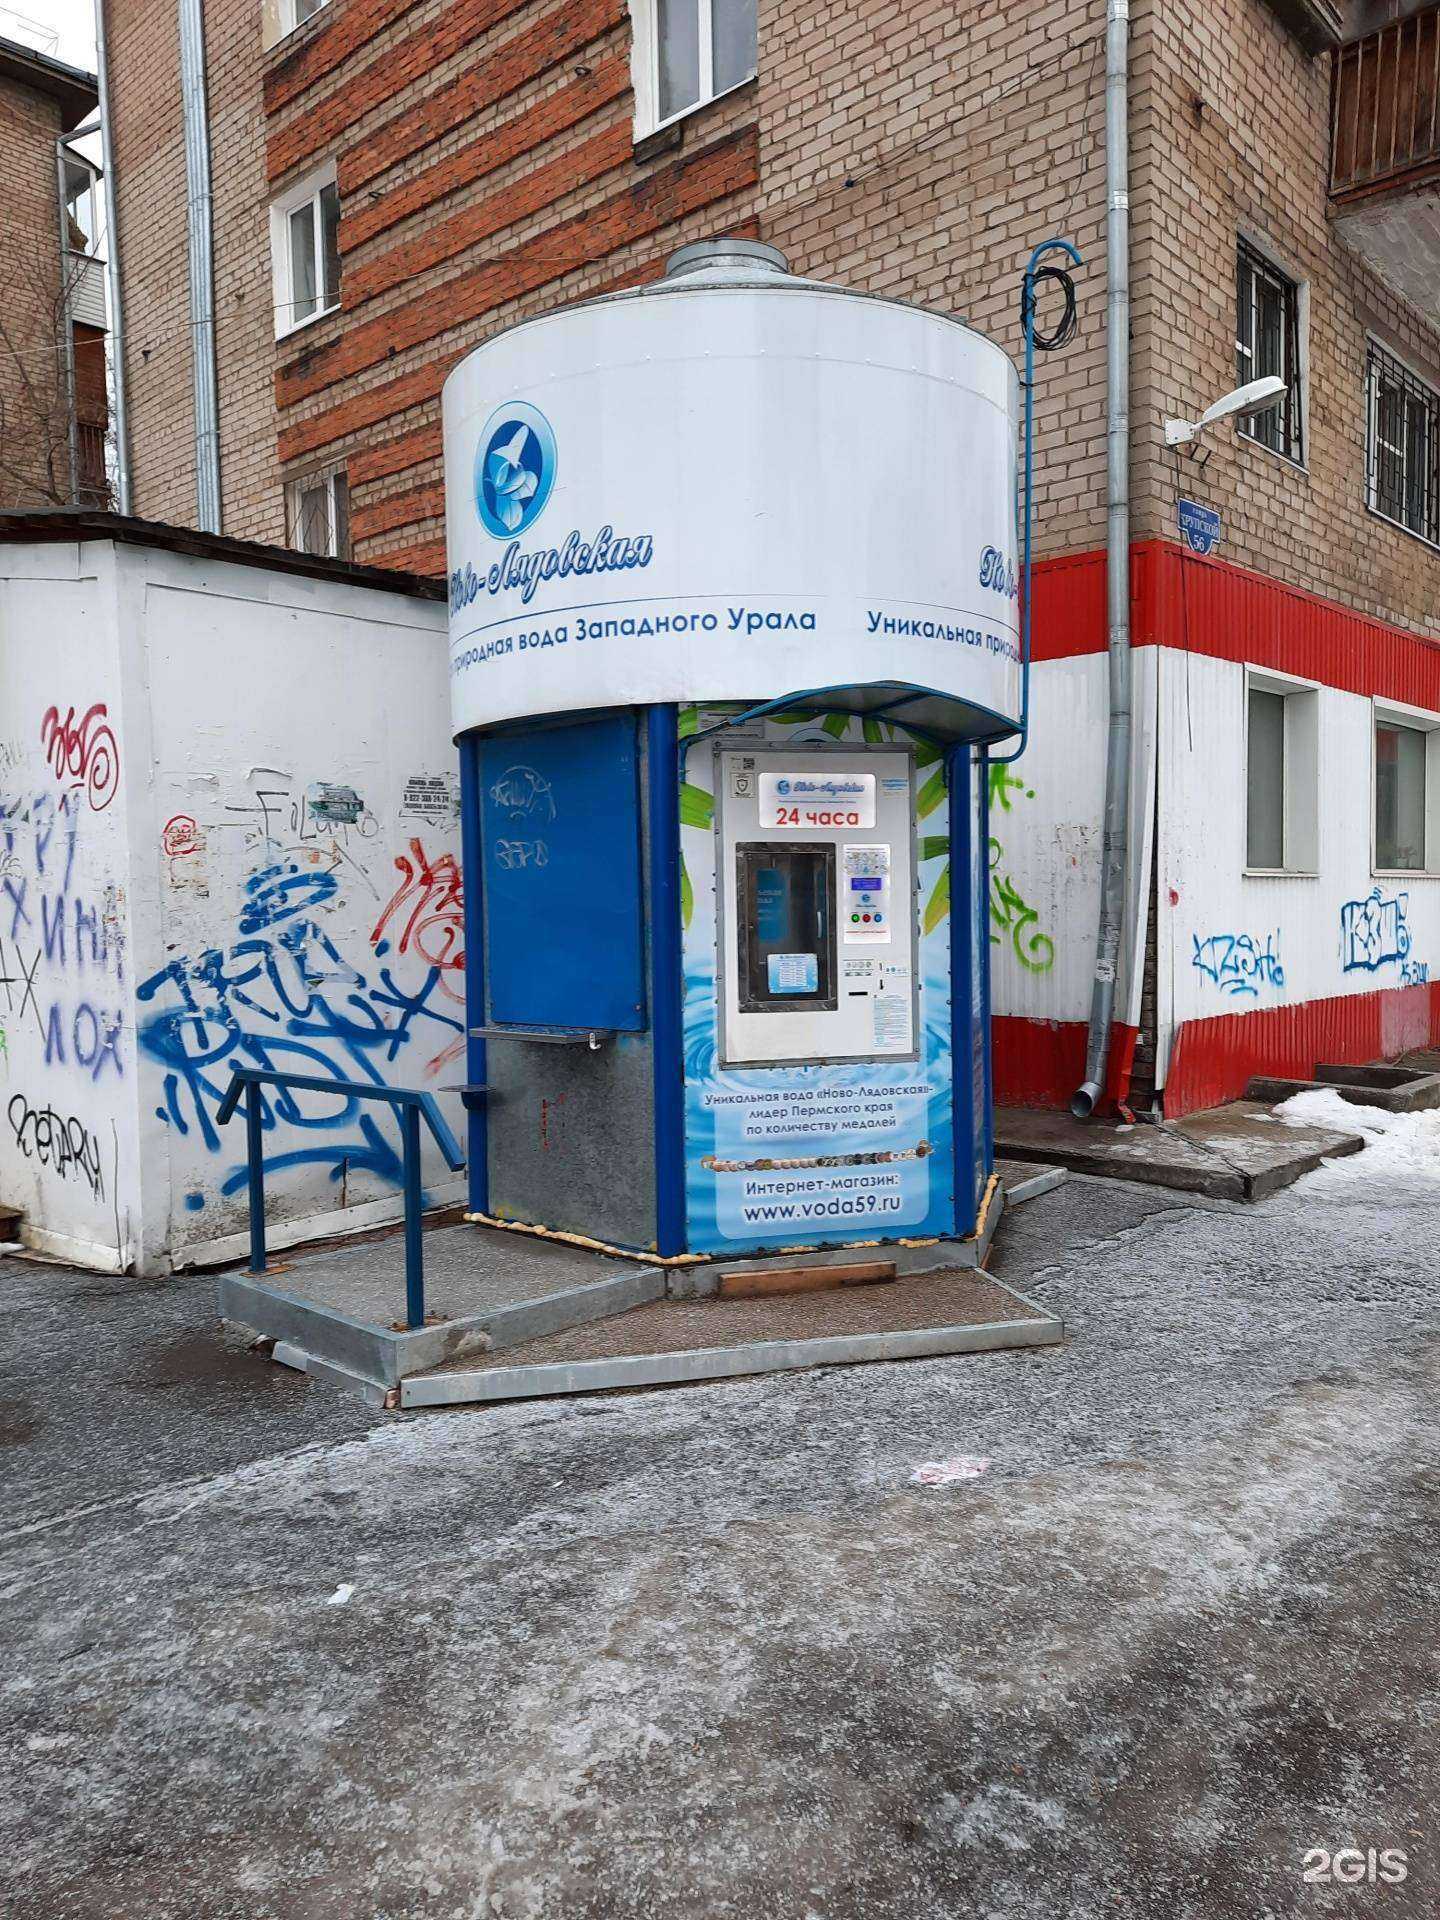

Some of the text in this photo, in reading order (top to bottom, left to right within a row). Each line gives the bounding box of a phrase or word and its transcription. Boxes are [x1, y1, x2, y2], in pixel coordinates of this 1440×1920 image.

[1193, 534, 1205, 552] 56
[519, 626, 568, 651] вода
[575, 612, 718, 641] Западного
[727, 607, 817, 634] Урала
[867, 610, 982, 648] Уникальная
[776, 807, 860, 826] 24 часа
[705, 1091, 779, 1105] Уникальная
[783, 1090, 814, 1102] вода
[748, 1102, 894, 1119] лидер Пермского края
[746, 1116, 897, 1135] по количеству медалей
[746, 1174, 899, 1196] Интернет-магазин:
[744, 1194, 901, 1222] www.voda59.ru
